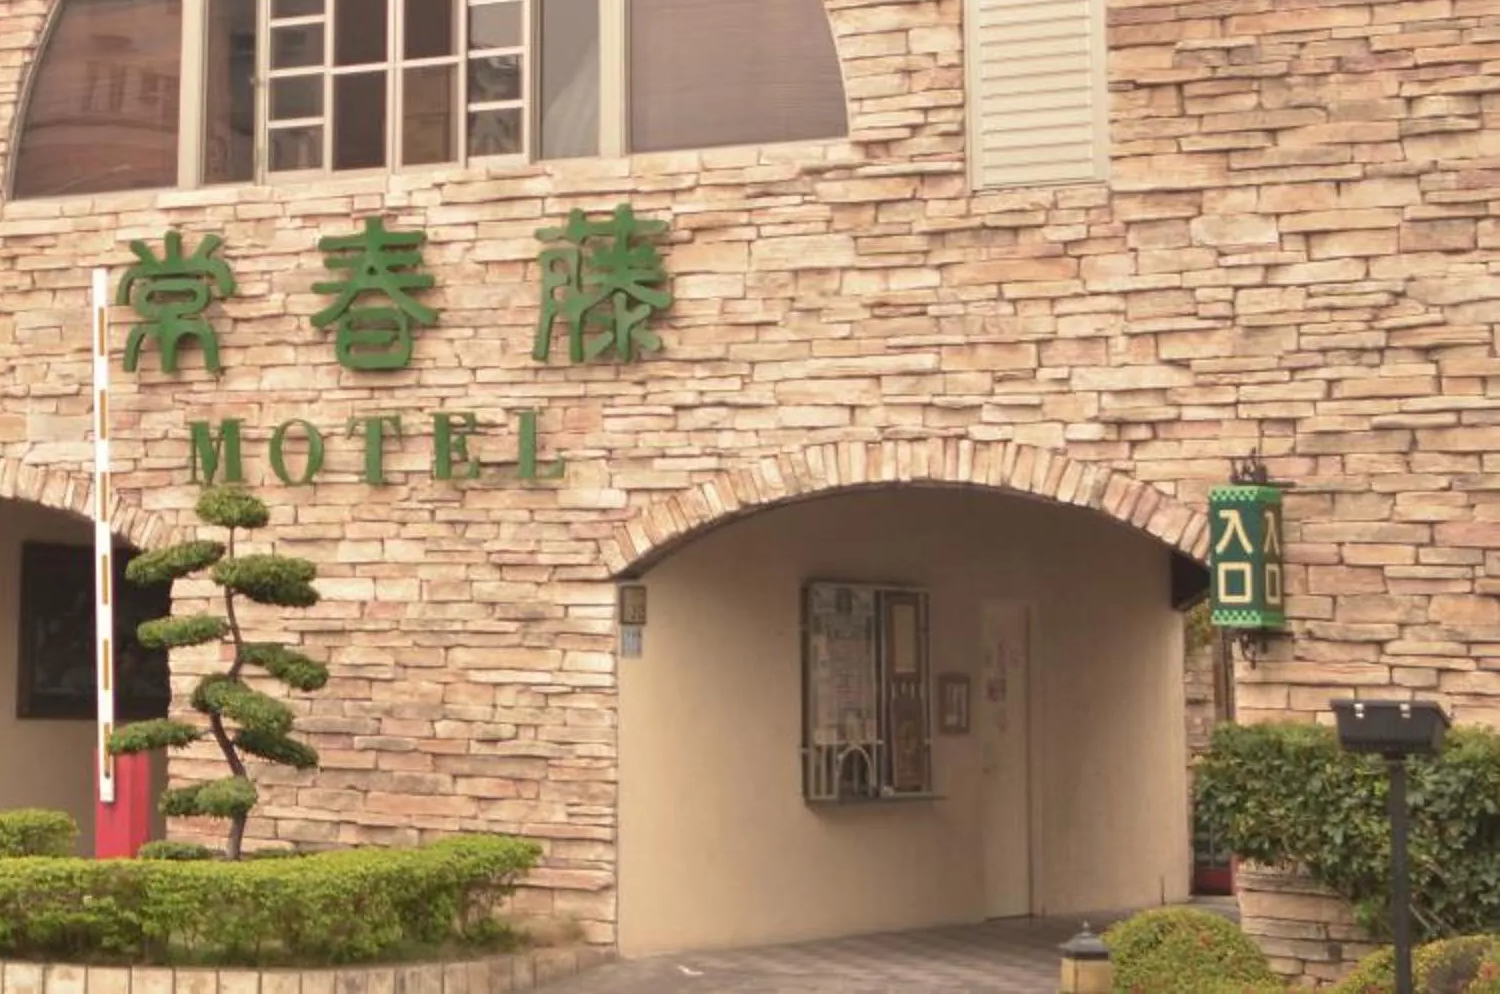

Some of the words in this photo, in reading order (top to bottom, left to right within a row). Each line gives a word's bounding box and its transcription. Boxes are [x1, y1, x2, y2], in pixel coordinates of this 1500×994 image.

[116, 204, 673, 374] 常春藤
[189, 410, 565, 487] MOTEL
[1215, 508, 1254, 604] 入口
[1263, 510, 1281, 605] 入口
